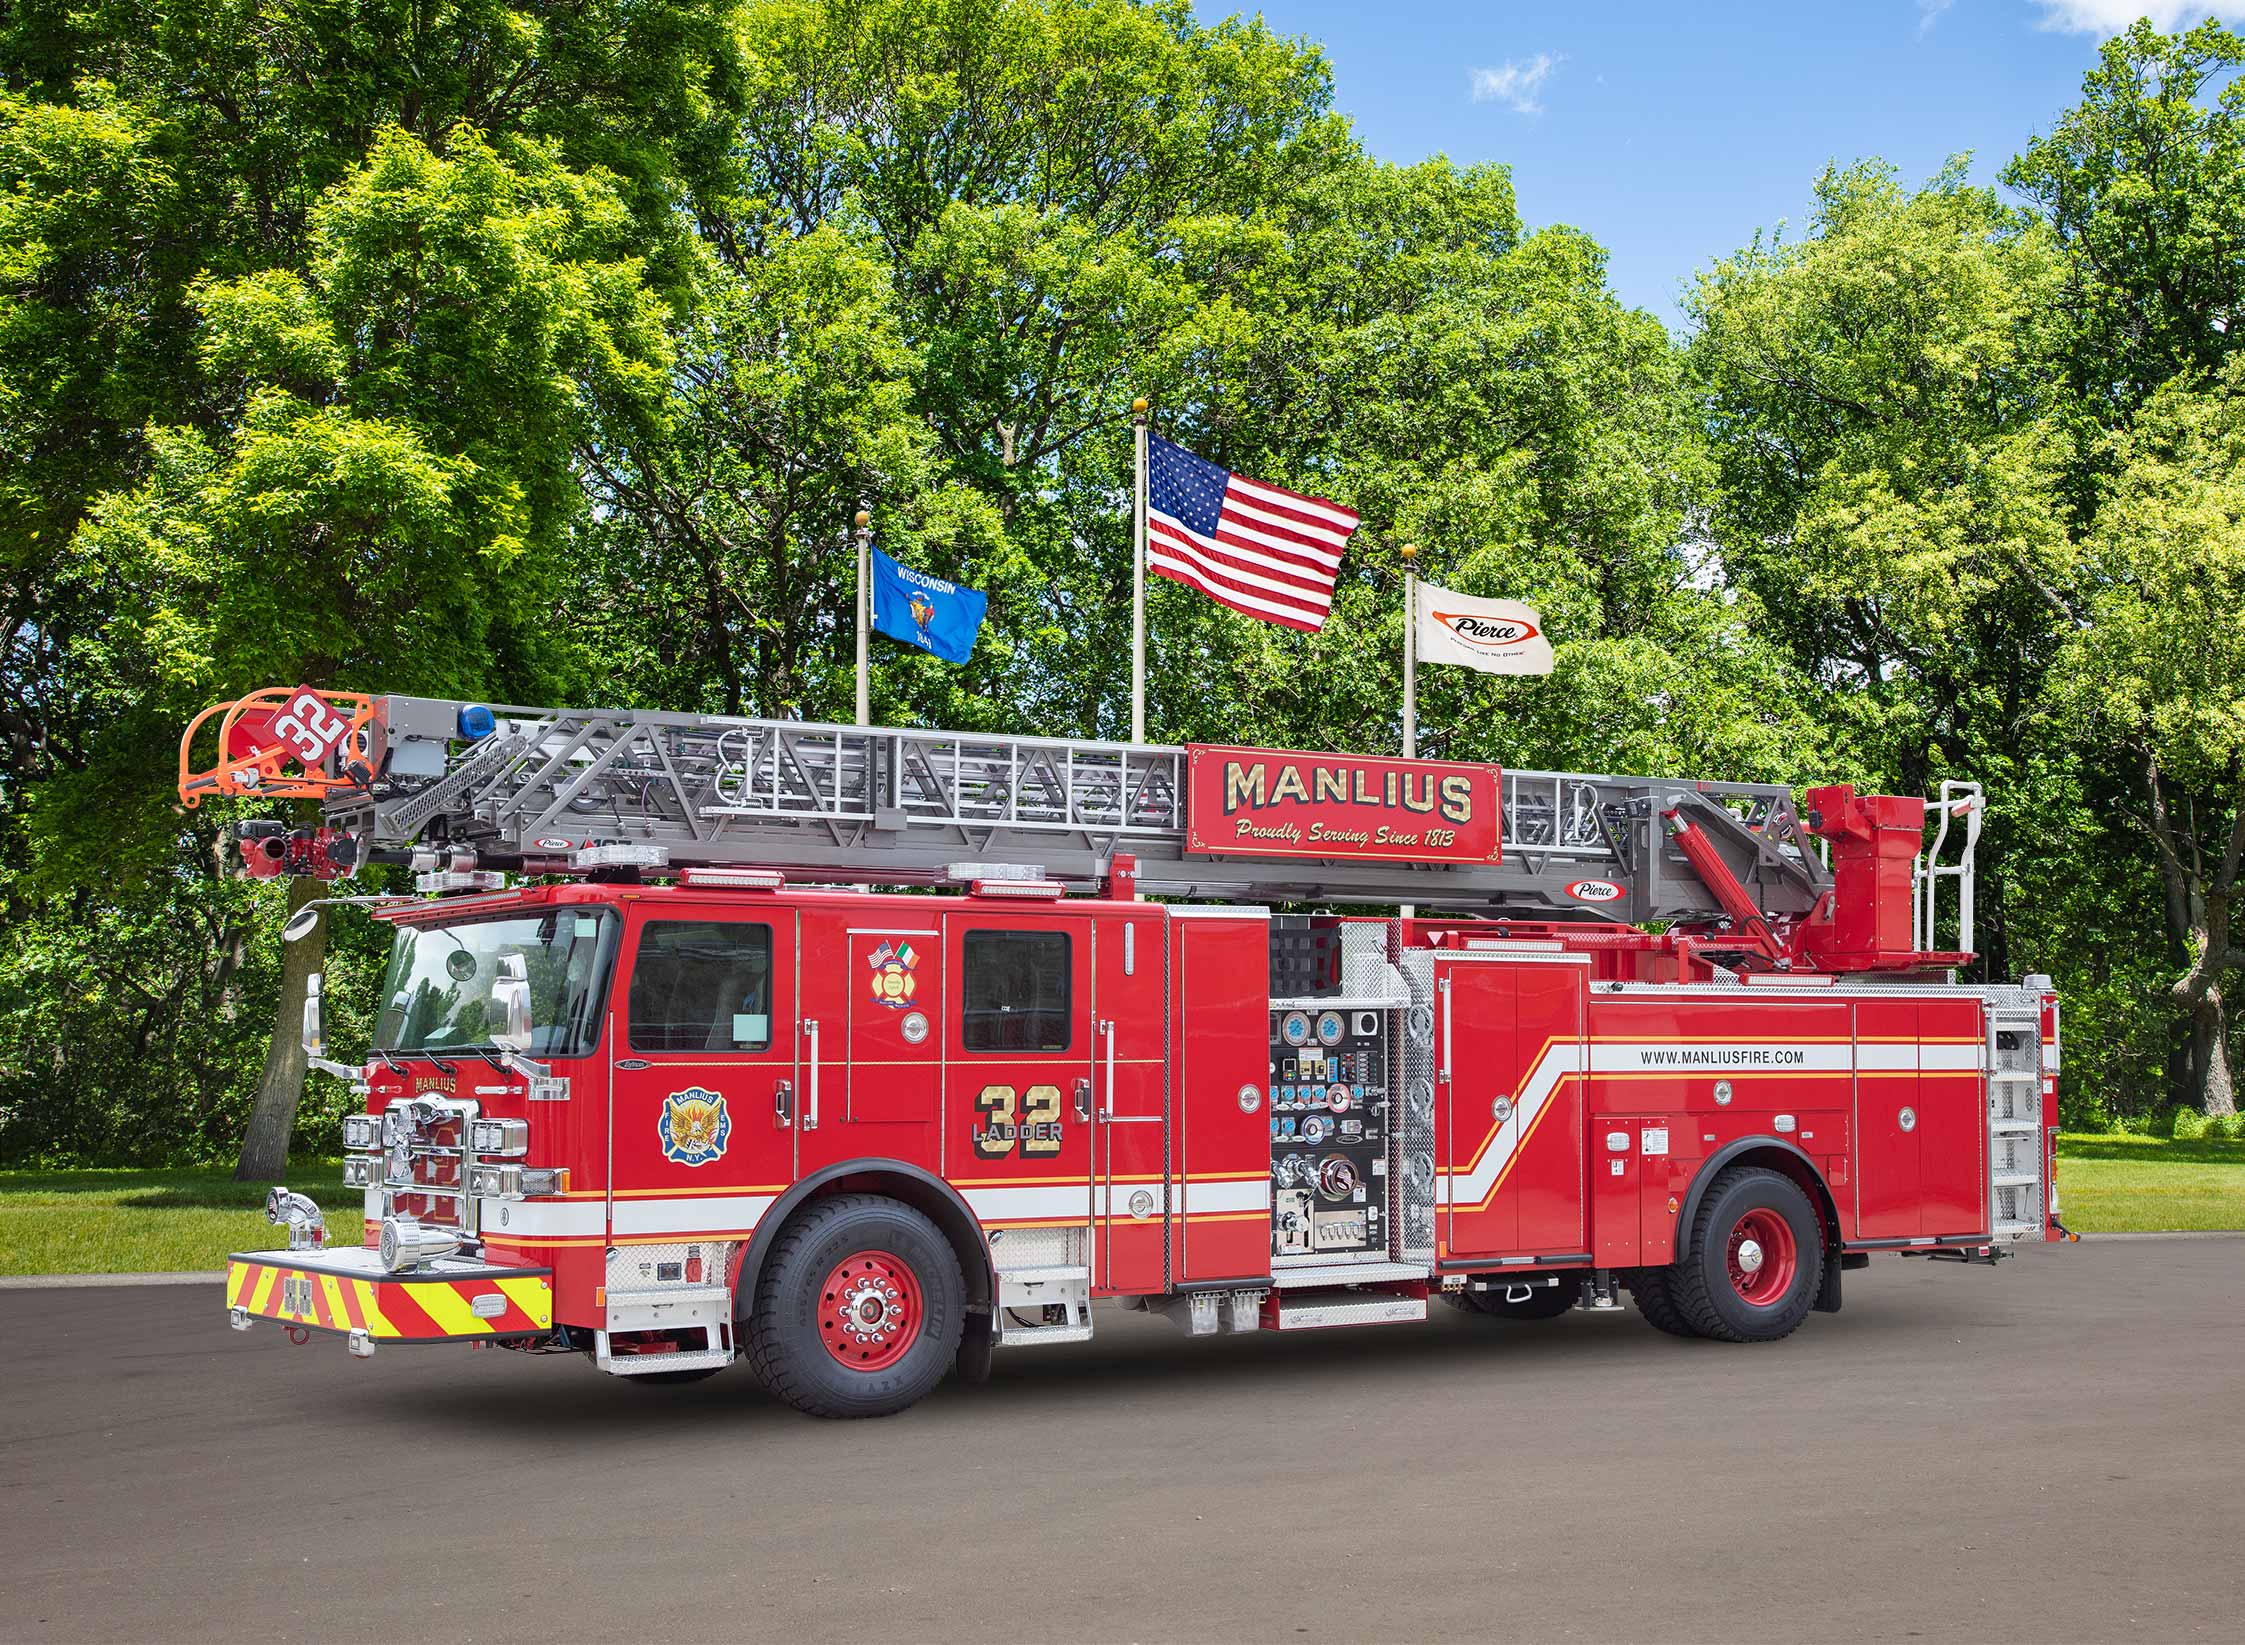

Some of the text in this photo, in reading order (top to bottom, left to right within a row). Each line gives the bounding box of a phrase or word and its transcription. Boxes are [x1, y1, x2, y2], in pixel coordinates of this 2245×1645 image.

[897, 566, 957, 595] WISCONSIN
[1455, 618, 1517, 639] Pierce
[274, 694, 346, 761] 32
[1223, 761, 1472, 825] MANLIUS
[1235, 818, 1455, 848] Proudly Serving Since 1813
[1578, 882, 1613, 896] Pierce
[1640, 1050, 1804, 1065] WWW.MANLIUSFIRE.COM
[415, 1077, 456, 1094] MANLIUS
[676, 1091, 714, 1105] MANLIUS
[972, 1123, 1063, 1142] LADDER
[974, 1084, 1062, 1160] 32
